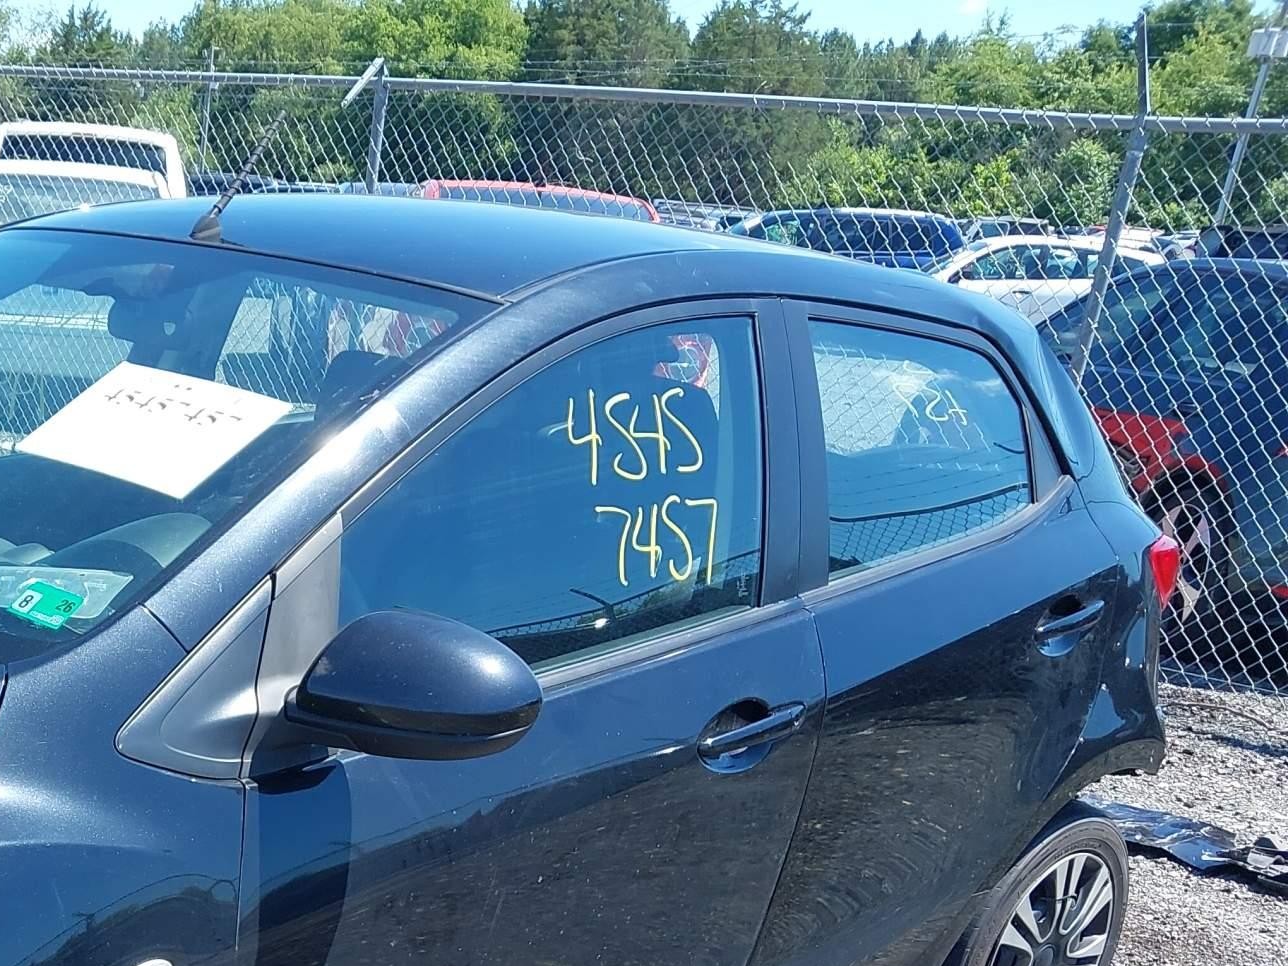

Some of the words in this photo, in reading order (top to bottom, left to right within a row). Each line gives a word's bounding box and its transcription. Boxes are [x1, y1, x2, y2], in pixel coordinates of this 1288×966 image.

[567, 386, 704, 486] 4545
[594, 494, 718, 587] 7457
[18, 594, 34, 608] 8
[55, 599, 77, 613] 26
